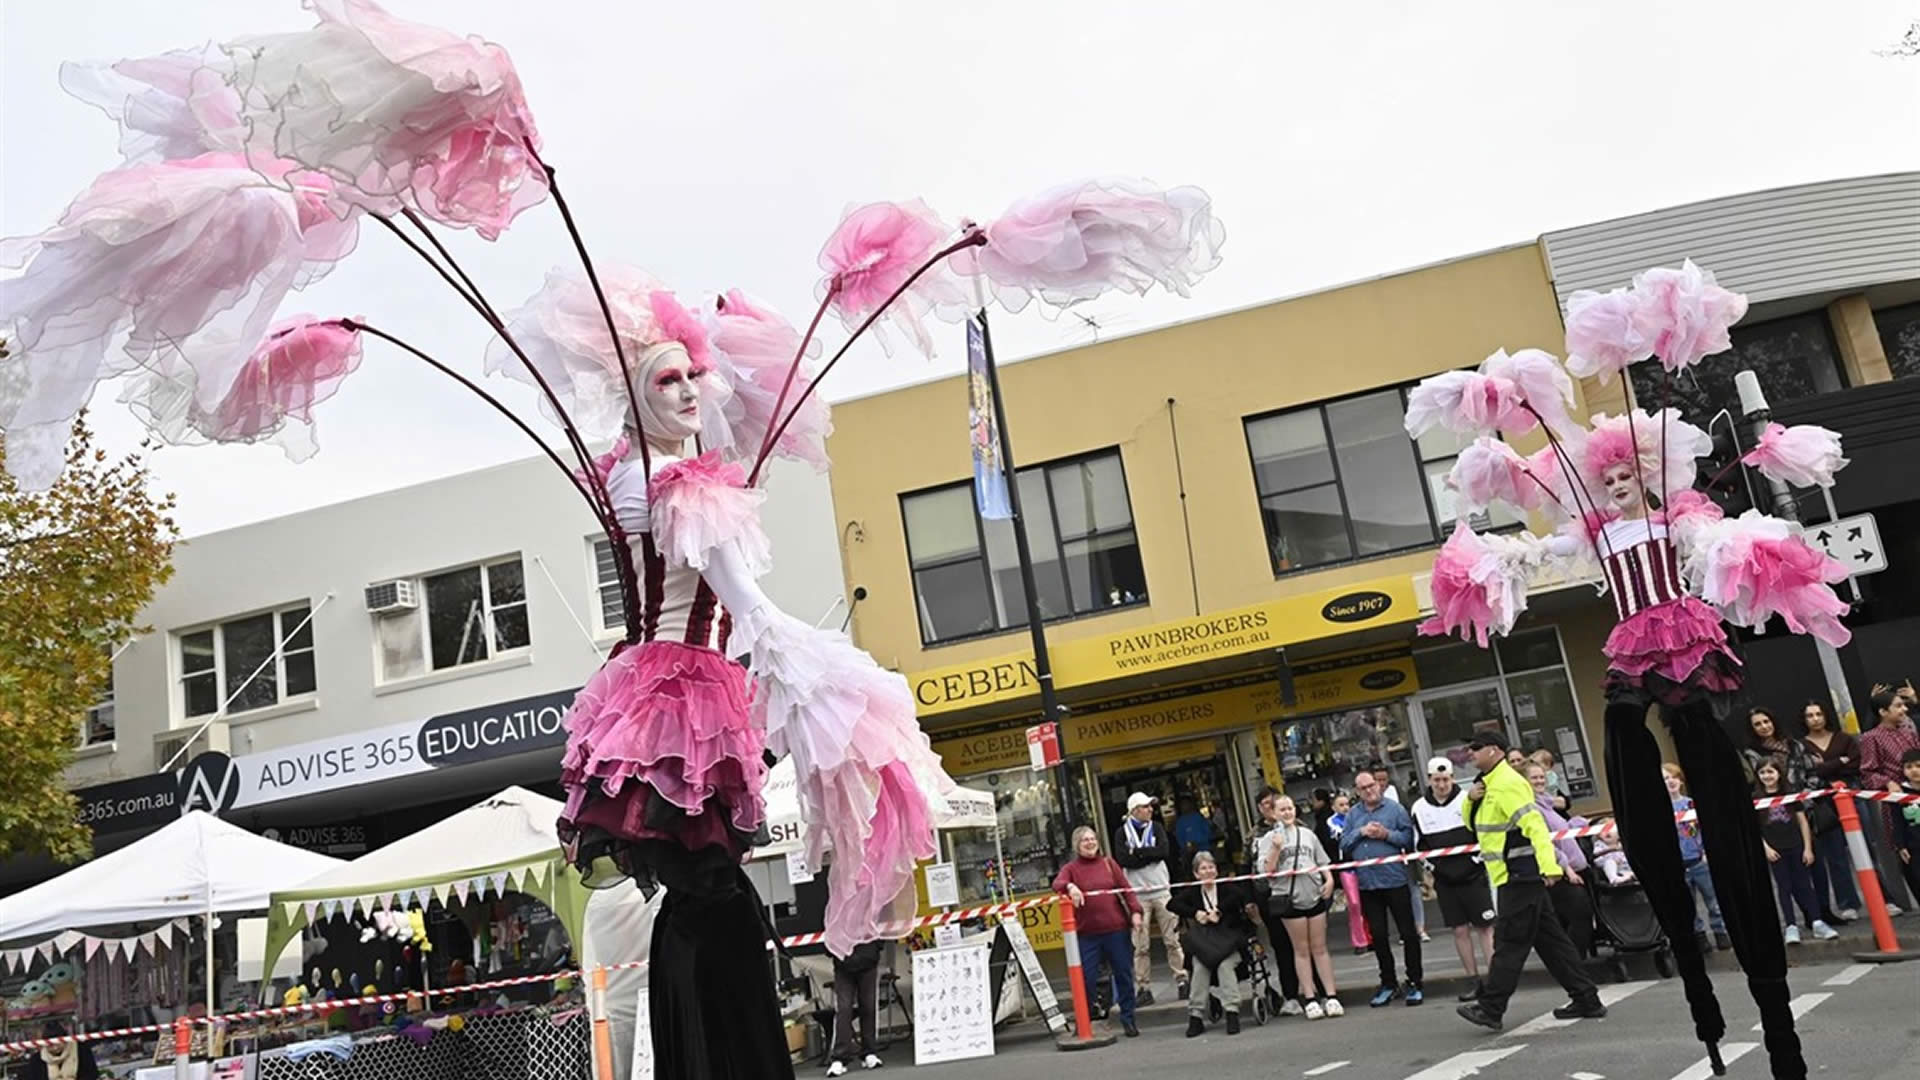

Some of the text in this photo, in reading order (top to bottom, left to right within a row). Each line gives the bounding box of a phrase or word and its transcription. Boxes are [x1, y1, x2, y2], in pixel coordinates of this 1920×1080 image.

[1329, 596, 1384, 618] Since 1907
[1109, 611, 1268, 656] PAWNBROKERS
[1116, 631, 1270, 670] www.aceben.com.au
[916, 658, 1041, 706] CEBEN
[425, 704, 568, 758] EDUCATIO
[1077, 702, 1215, 740] PAWNBROKERS
[258, 735, 414, 791] ADVISE 365
[960, 732, 1027, 757] ACEBE
[288, 825, 366, 845] ADVISE 365
[1034, 929, 1063, 945] HER
